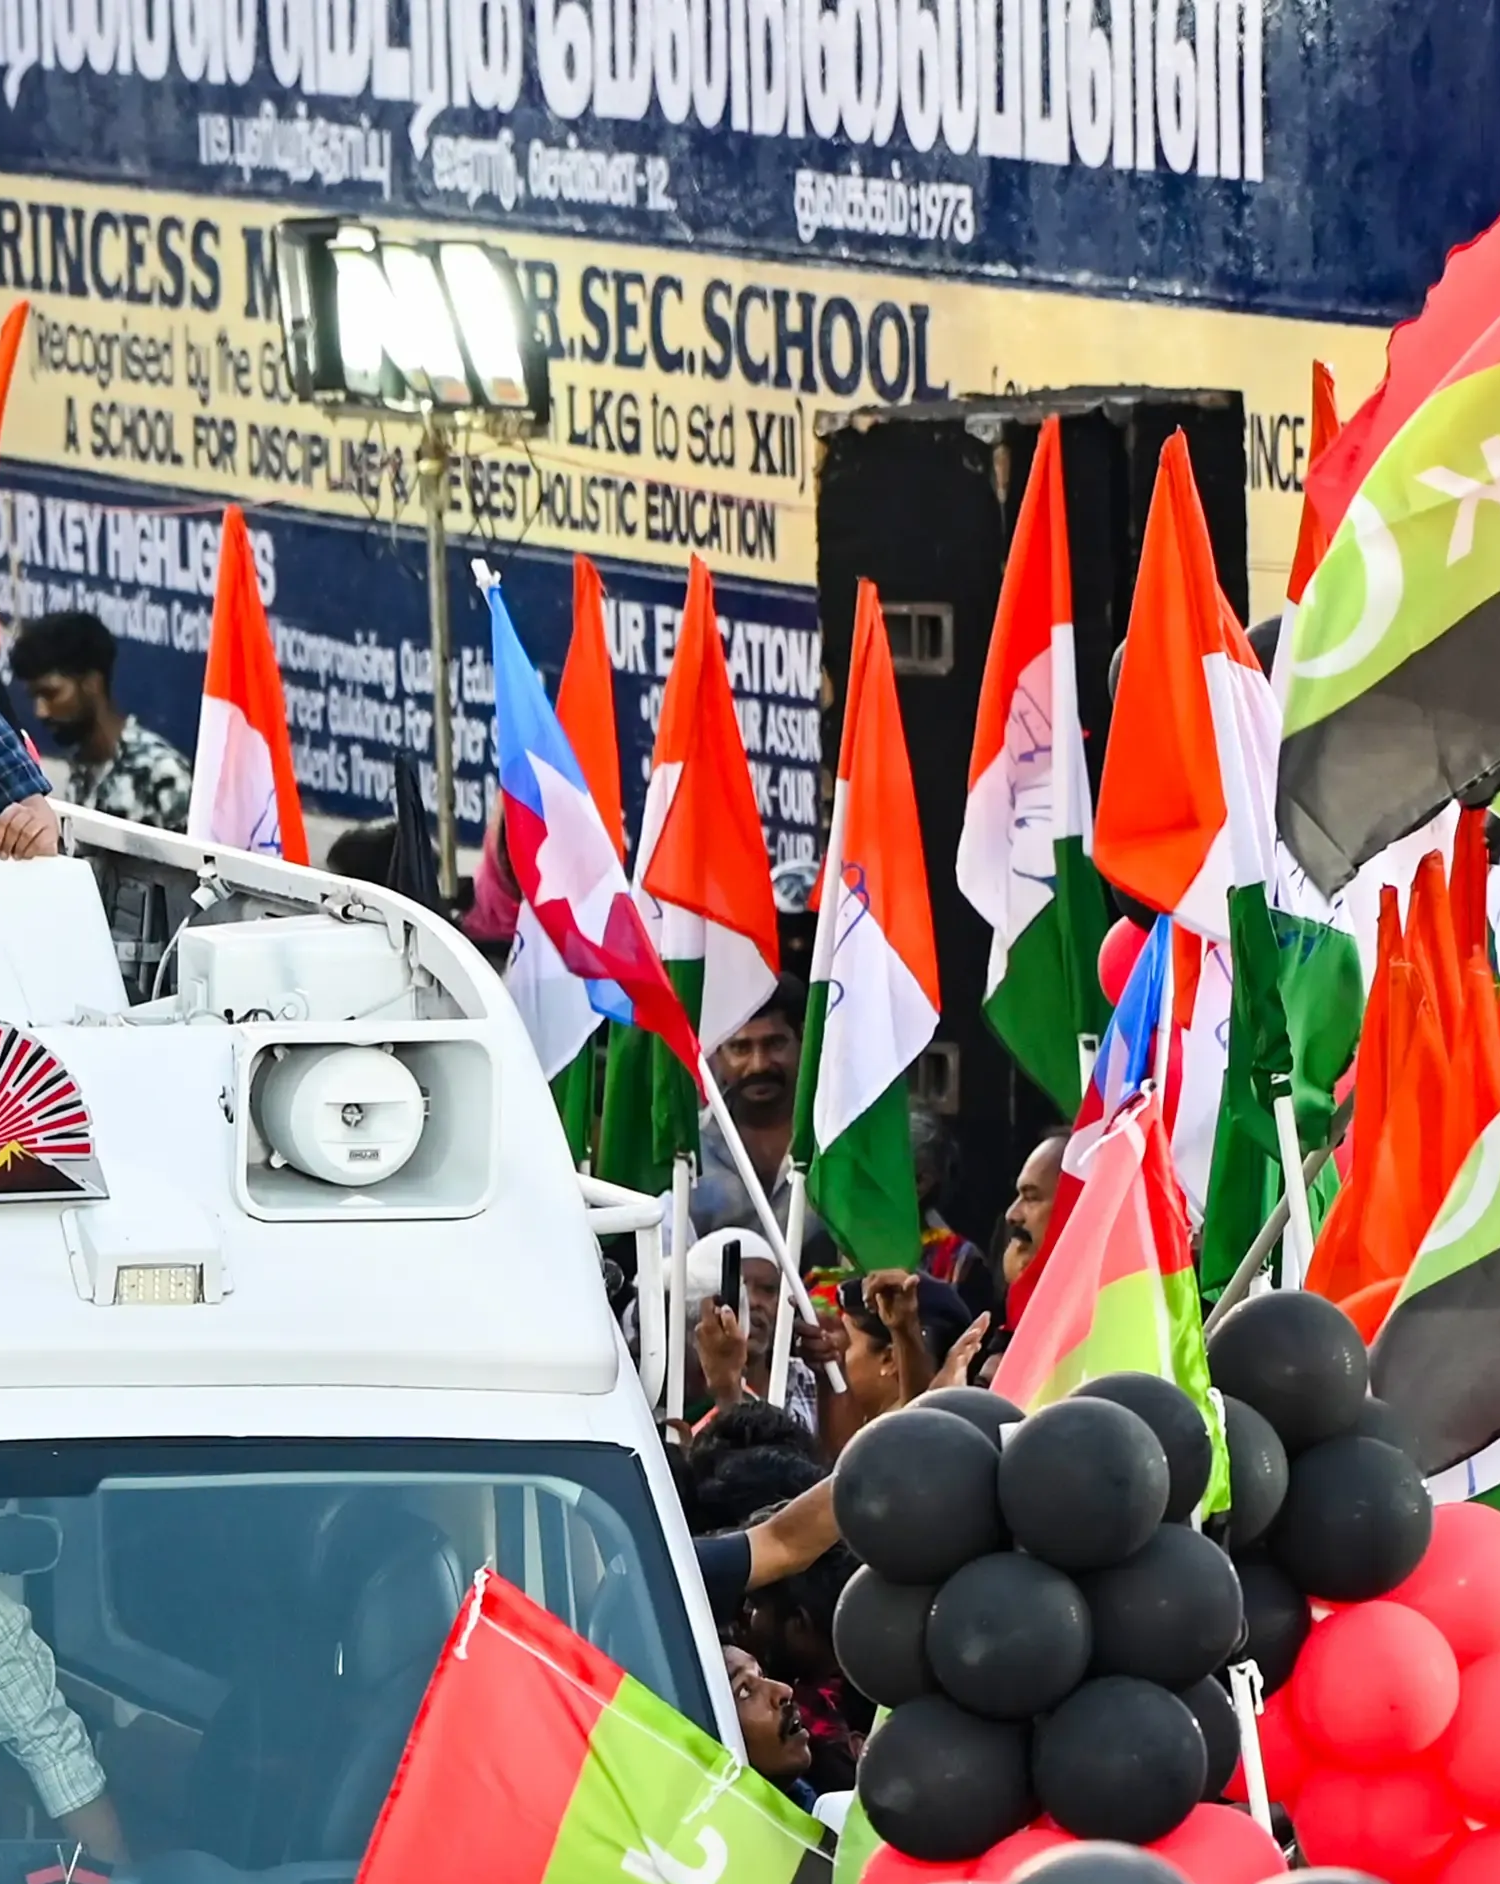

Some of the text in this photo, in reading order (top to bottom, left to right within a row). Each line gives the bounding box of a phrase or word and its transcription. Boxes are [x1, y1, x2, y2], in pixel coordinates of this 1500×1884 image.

[185, 322, 211, 408] by
[566, 385, 641, 456] LKG
[651, 392, 679, 461] to
[686, 403, 735, 468] Std
[1245, 412, 1306, 492] INCE
[64, 396, 81, 455] A
[89, 401, 184, 467] SCHOOL
[193, 413, 238, 478] FOR
[247, 423, 381, 500] DISCIPLINE
[470, 458, 531, 520] BEST
[541, 470, 638, 538] HOLISTIC
[645, 480, 778, 561] EDUCATION
[45, 505, 101, 578] KEY
[602, 597, 647, 675] UR
